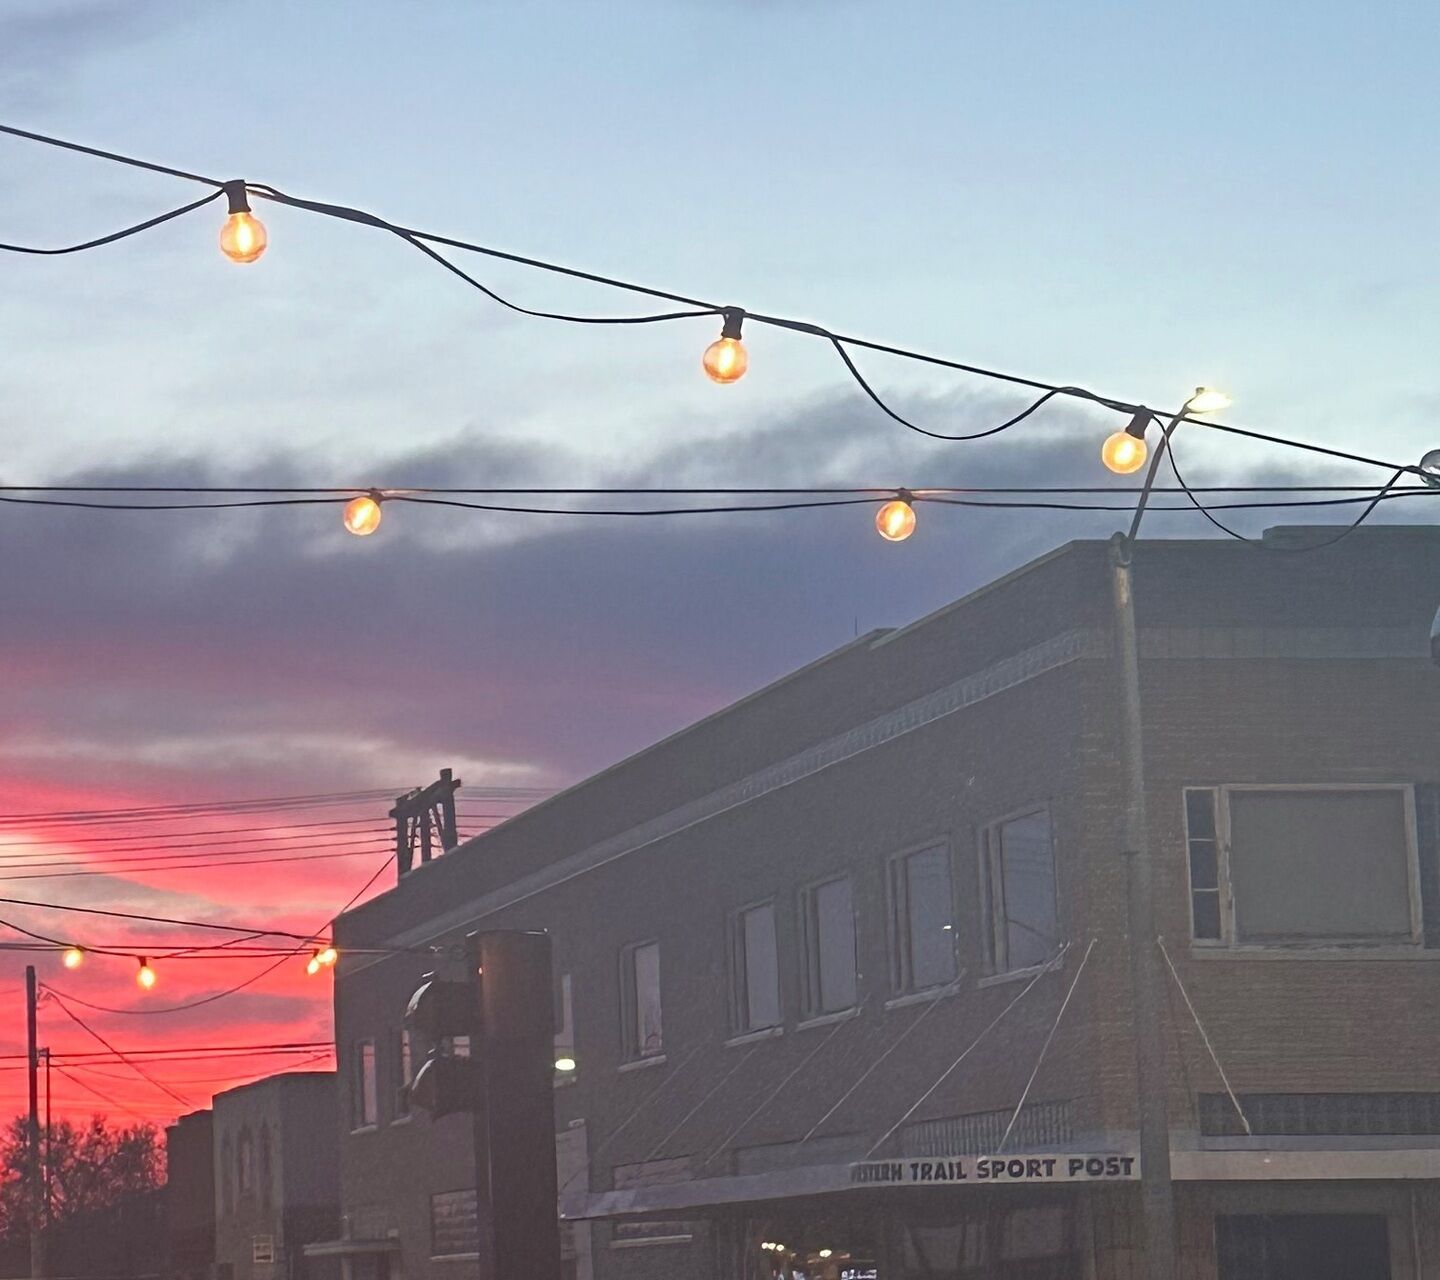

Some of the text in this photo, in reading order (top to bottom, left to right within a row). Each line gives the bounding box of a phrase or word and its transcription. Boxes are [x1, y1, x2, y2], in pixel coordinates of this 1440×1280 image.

[910, 1161, 967, 1181] TRAIL
[977, 1159, 1057, 1179] SPORT
[1068, 1157, 1135, 1177] POST
